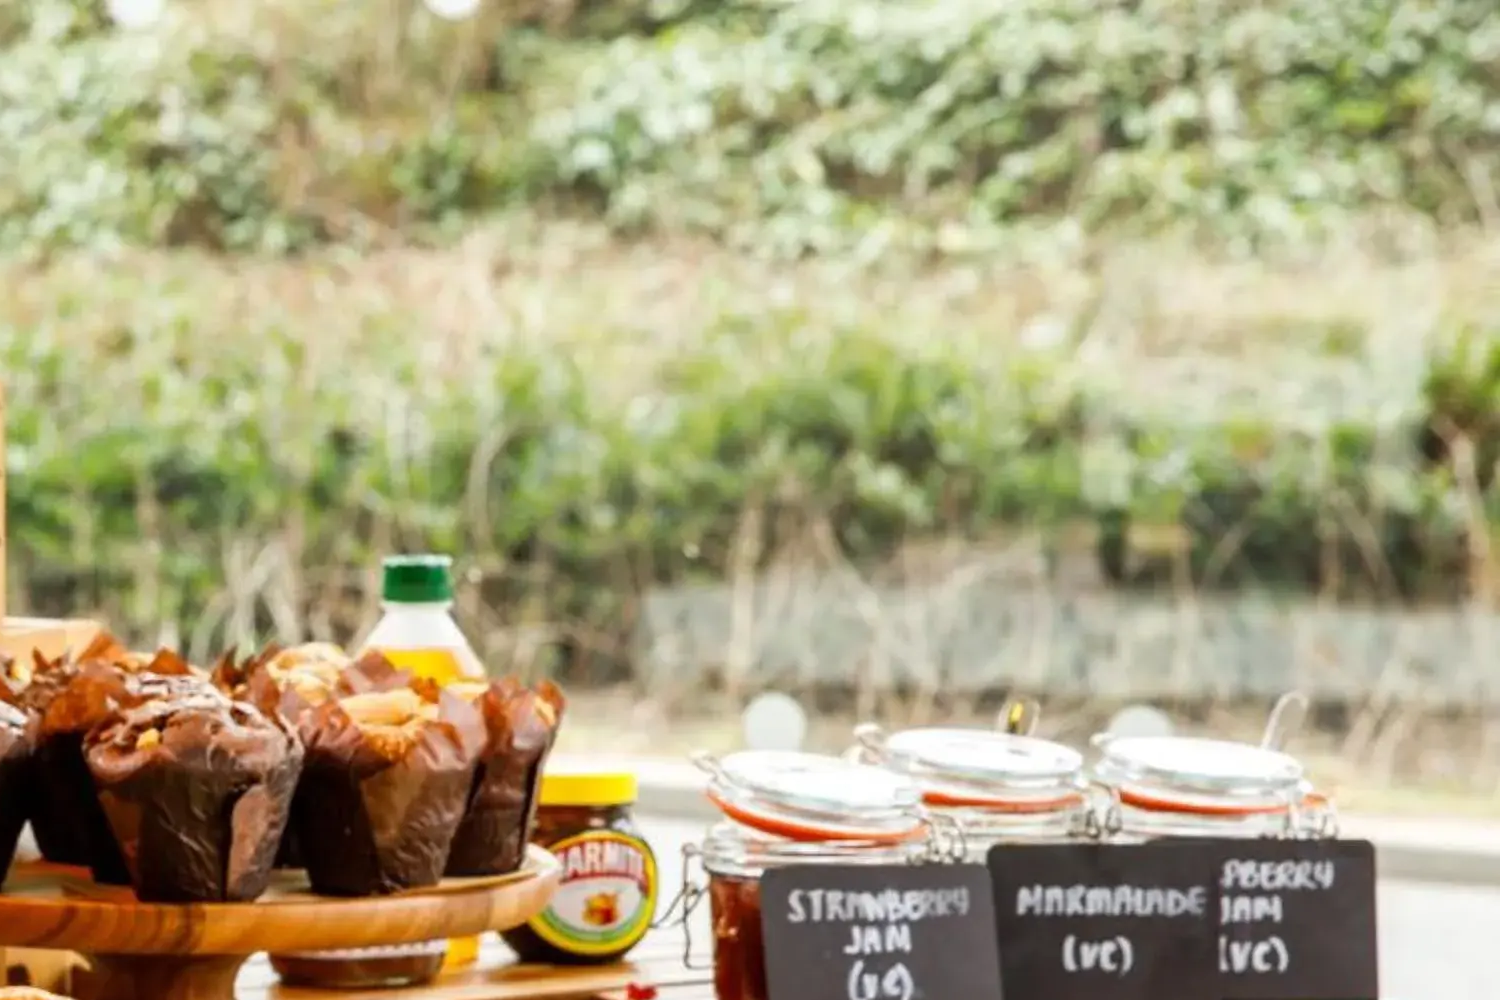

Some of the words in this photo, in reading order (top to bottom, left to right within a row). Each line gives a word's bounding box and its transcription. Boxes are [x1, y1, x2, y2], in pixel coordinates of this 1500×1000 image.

[1220, 858, 1335, 890] PBERRY
[1016, 884, 1207, 917] MARMALADE
[843, 924, 912, 955] JAM
